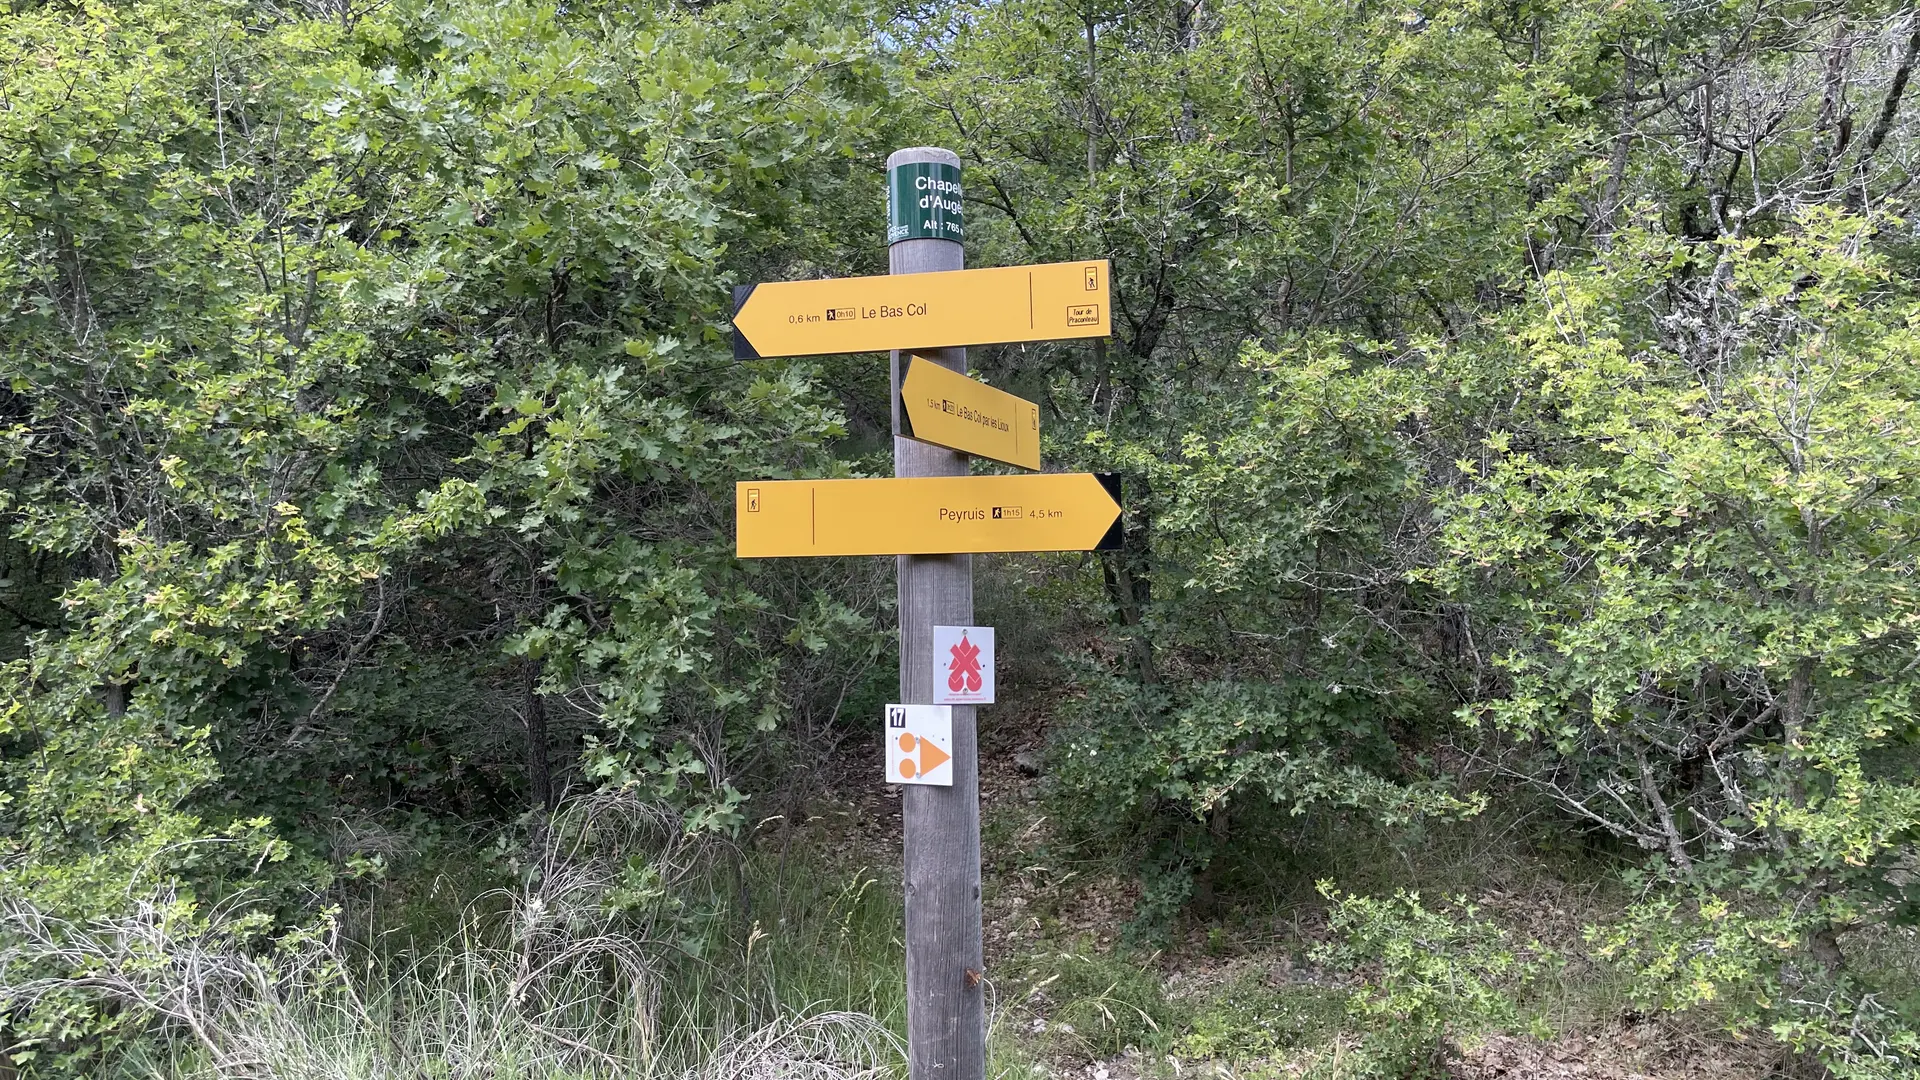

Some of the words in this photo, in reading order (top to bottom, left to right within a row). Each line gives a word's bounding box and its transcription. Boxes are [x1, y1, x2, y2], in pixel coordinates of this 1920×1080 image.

[915, 176, 963, 197] Chapel
[919, 195, 964, 215] d'Augè
[923, 219, 938, 230] Alt
[945, 222, 960, 234] 765
[788, 312, 804, 324] 0,6
[806, 311, 821, 323] km
[836, 308, 854, 317] 0h10
[861, 305, 877, 316] Le
[880, 303, 903, 315] Bas
[906, 301, 927, 314] Col
[1073, 308, 1084, 316] Tour
[1086, 307, 1092, 315] de
[934, 400, 941, 410] km
[956, 403, 963, 417] Le
[963, 406, 973, 421] Bas
[973, 409, 982, 424] Col
[982, 415, 990, 428] par
[939, 507, 985, 523] Peyruis
[1003, 509, 1020, 517] 1h15
[1029, 509, 1045, 519] 4,5
[1048, 509, 1064, 518] km
[891, 708, 904, 727] 17
